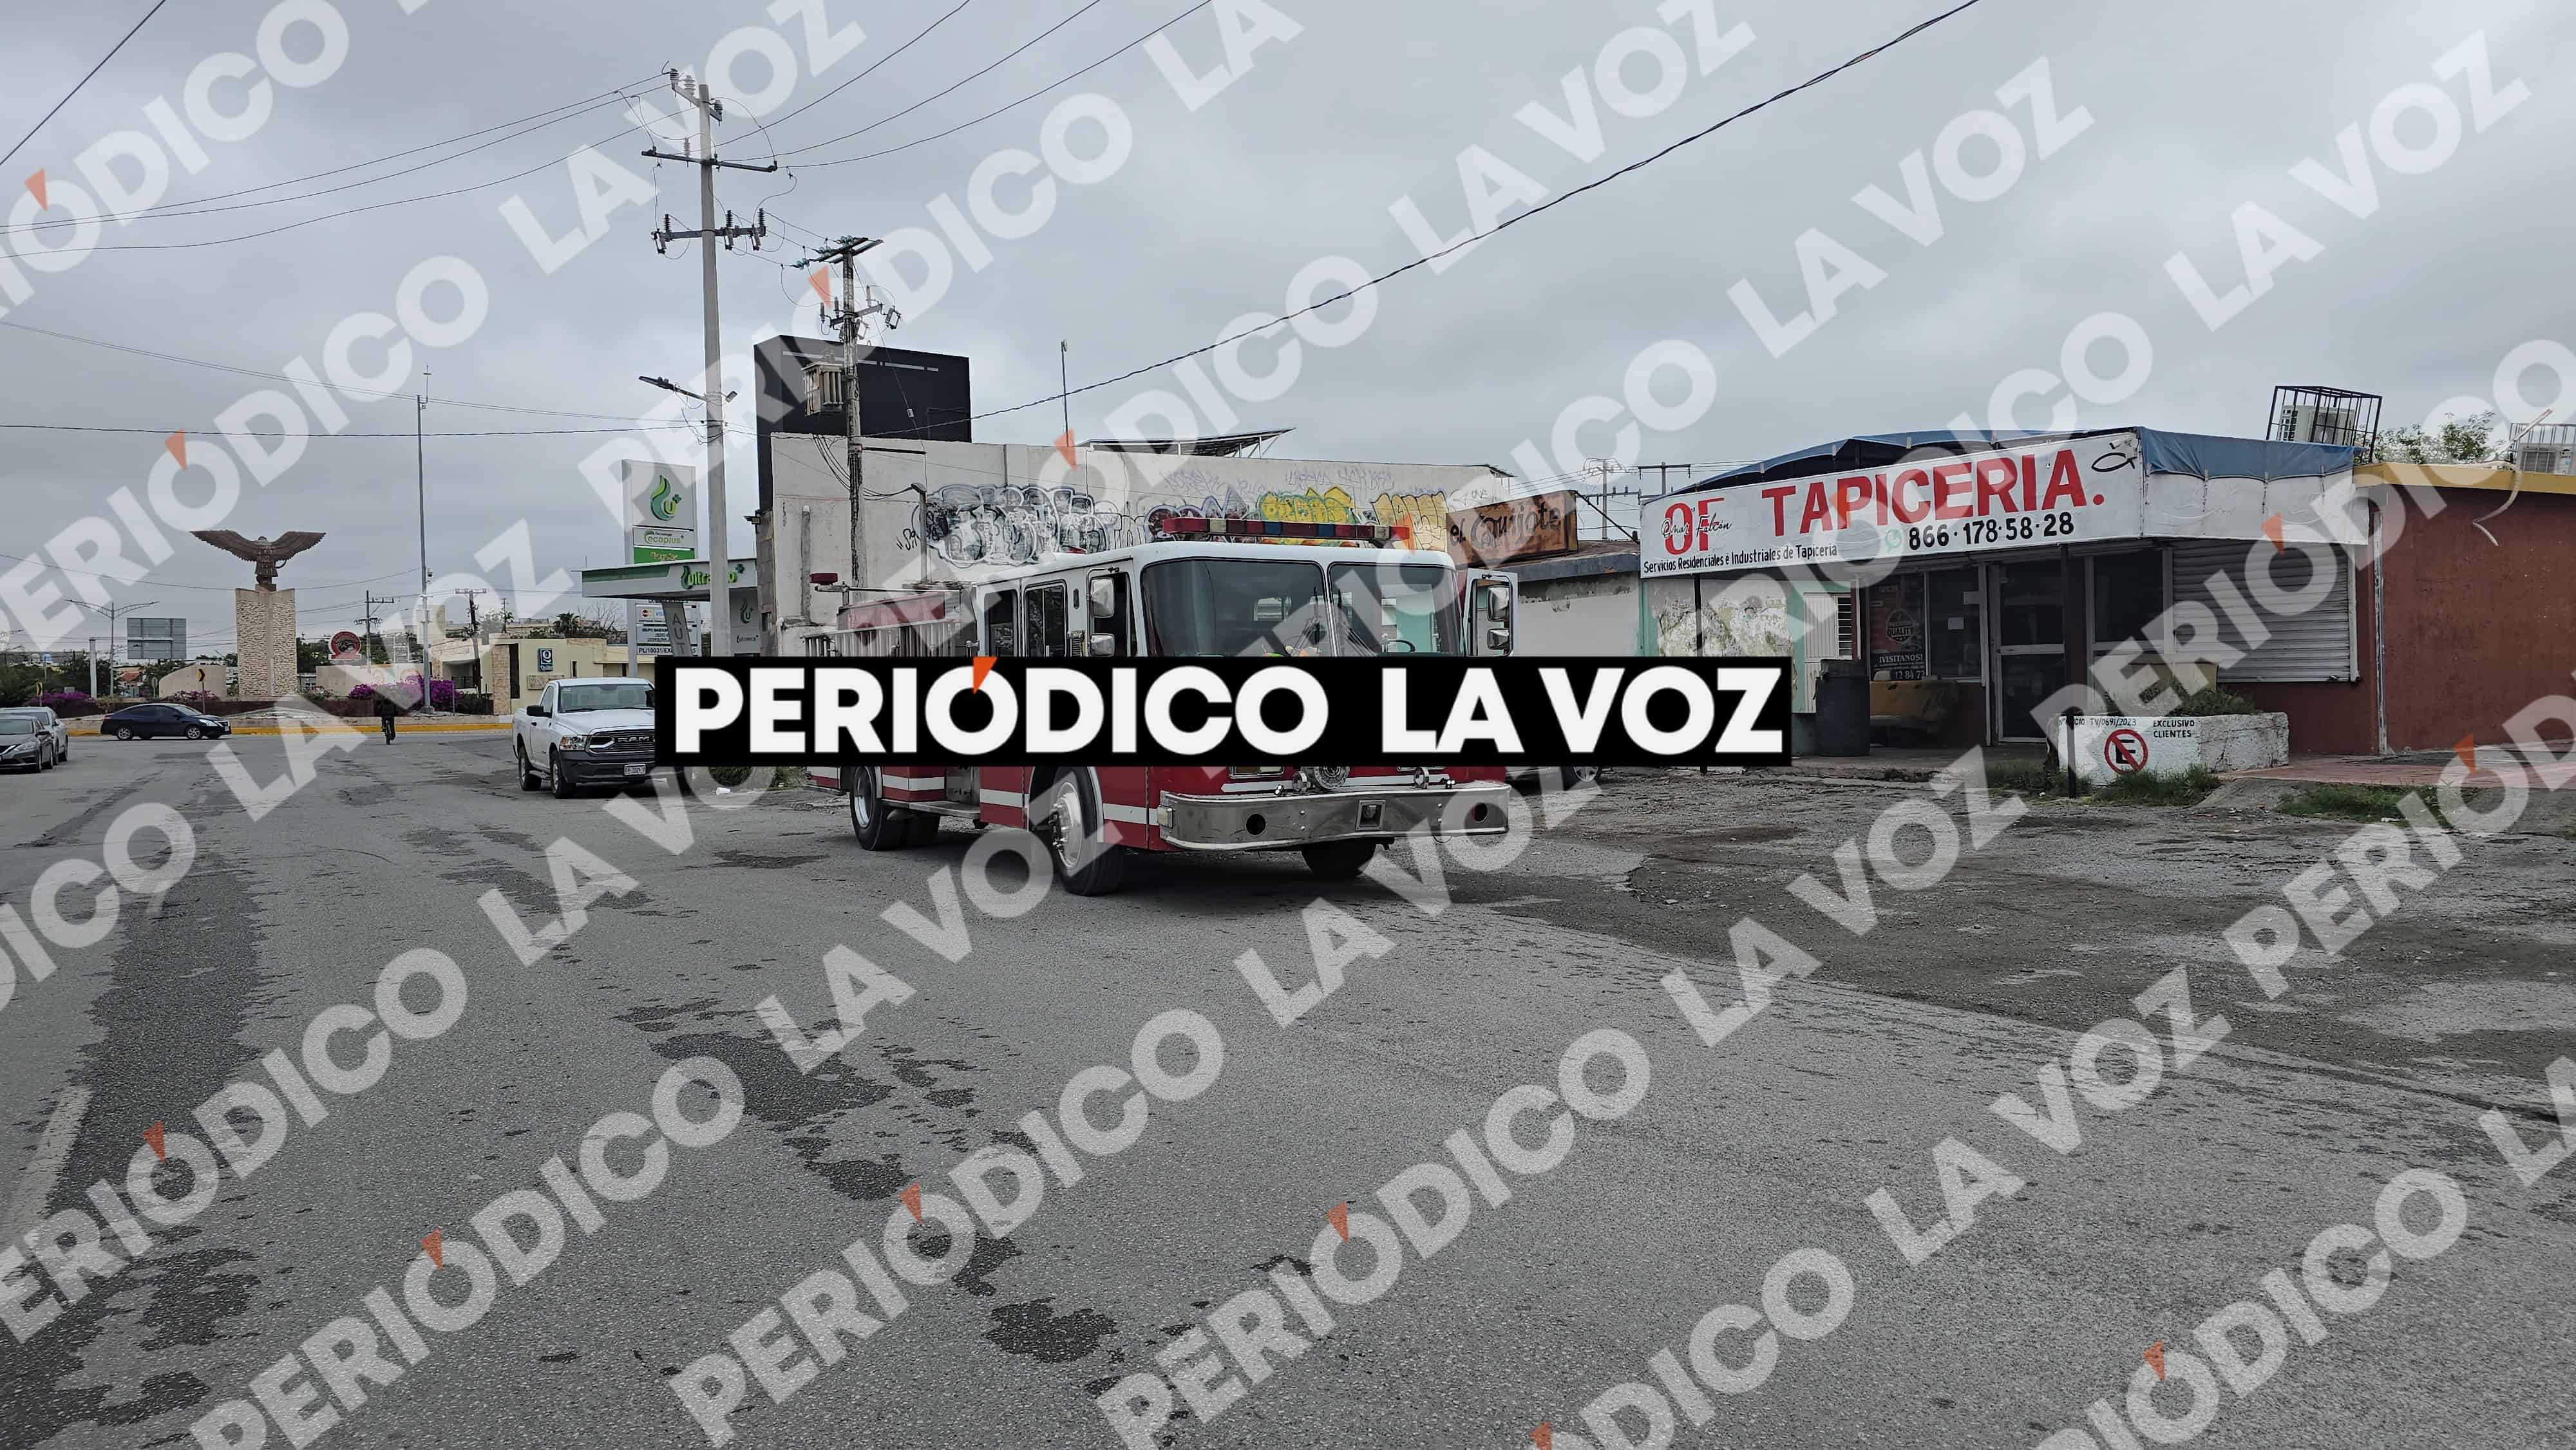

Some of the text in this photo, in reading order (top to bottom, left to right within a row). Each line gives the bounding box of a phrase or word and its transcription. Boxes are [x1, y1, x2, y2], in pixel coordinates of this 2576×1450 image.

[1761, 449, 2105, 536] TAPICERIA.
[1643, 558, 1676, 573] Servicios
[1678, 555, 1724, 570] Residenciales
[1732, 547, 1781, 565] Industriales
[1783, 547, 1794, 560] de
[2153, 719, 2195, 728] EXCLUSIVO
[2154, 730, 2192, 738] CLIENTES
